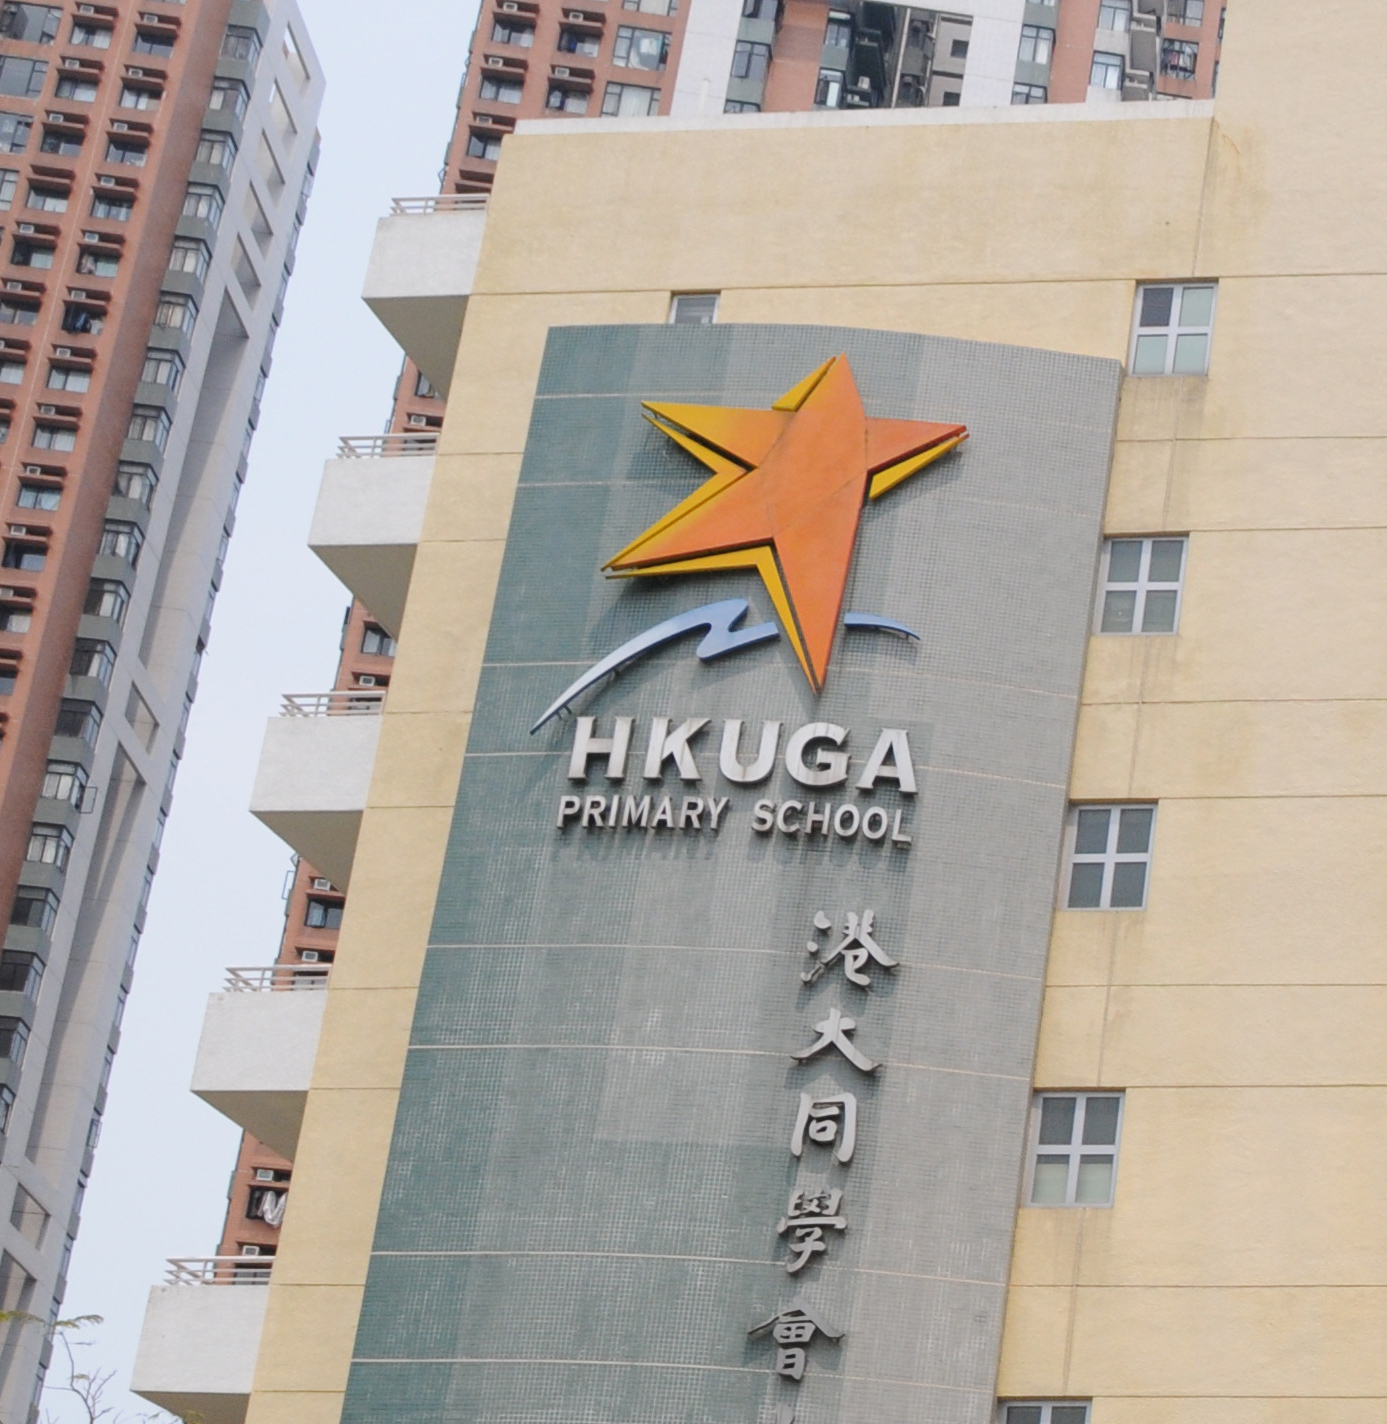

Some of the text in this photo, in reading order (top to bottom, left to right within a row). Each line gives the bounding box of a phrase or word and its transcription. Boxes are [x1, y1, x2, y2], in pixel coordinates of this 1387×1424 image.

[567, 715, 918, 796] HKUGA
[556, 794, 913, 849] PRIMARY SCHOOL
